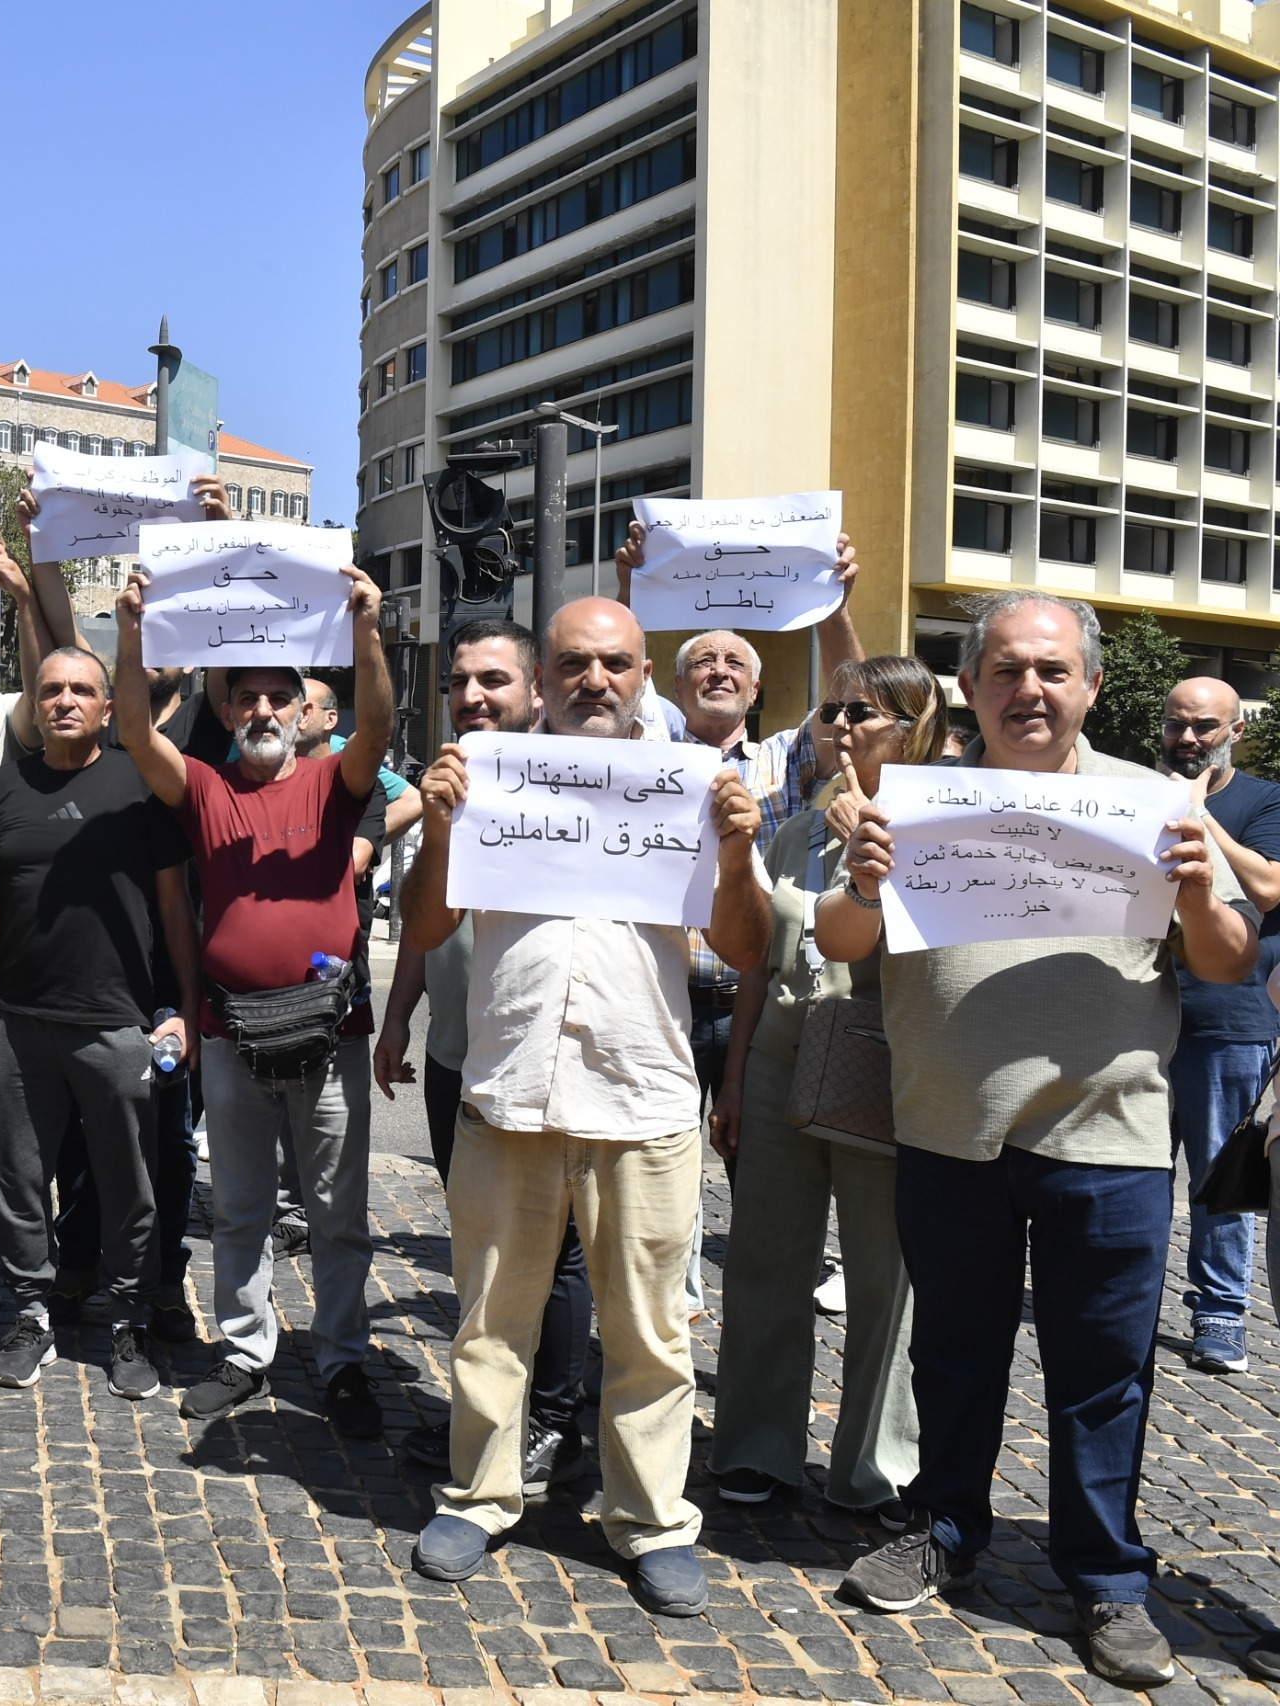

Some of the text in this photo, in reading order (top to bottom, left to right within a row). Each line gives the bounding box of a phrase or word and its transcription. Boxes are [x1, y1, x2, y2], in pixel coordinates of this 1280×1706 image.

[154, 499, 174, 509] من
[748, 519, 765, 530] مع
[771, 508, 832, 528] الضعفان
[152, 539, 199, 557] الرجعي
[204, 537, 250, 553] المفعول
[704, 541, 771, 561] حق
[214, 566, 278, 587] حق
[673, 566, 799, 582] والحرمان منه
[184, 597, 309, 615] والحرمان منه
[695, 589, 774, 614] باطل
[208, 625, 285, 648] باطل
[624, 768, 684, 803] كفى
[927, 789, 1135, 821] بعد 40 عاما من العطاء
[480, 813, 701, 861] بحقوق العاملين
[991, 822, 1062, 841] لا تثبيت
[913, 844, 1136, 879] وتعويض نهاية خدمة ثمن
[905, 872, 1140, 896] بخس لا يتجاوز سعر ربطة
